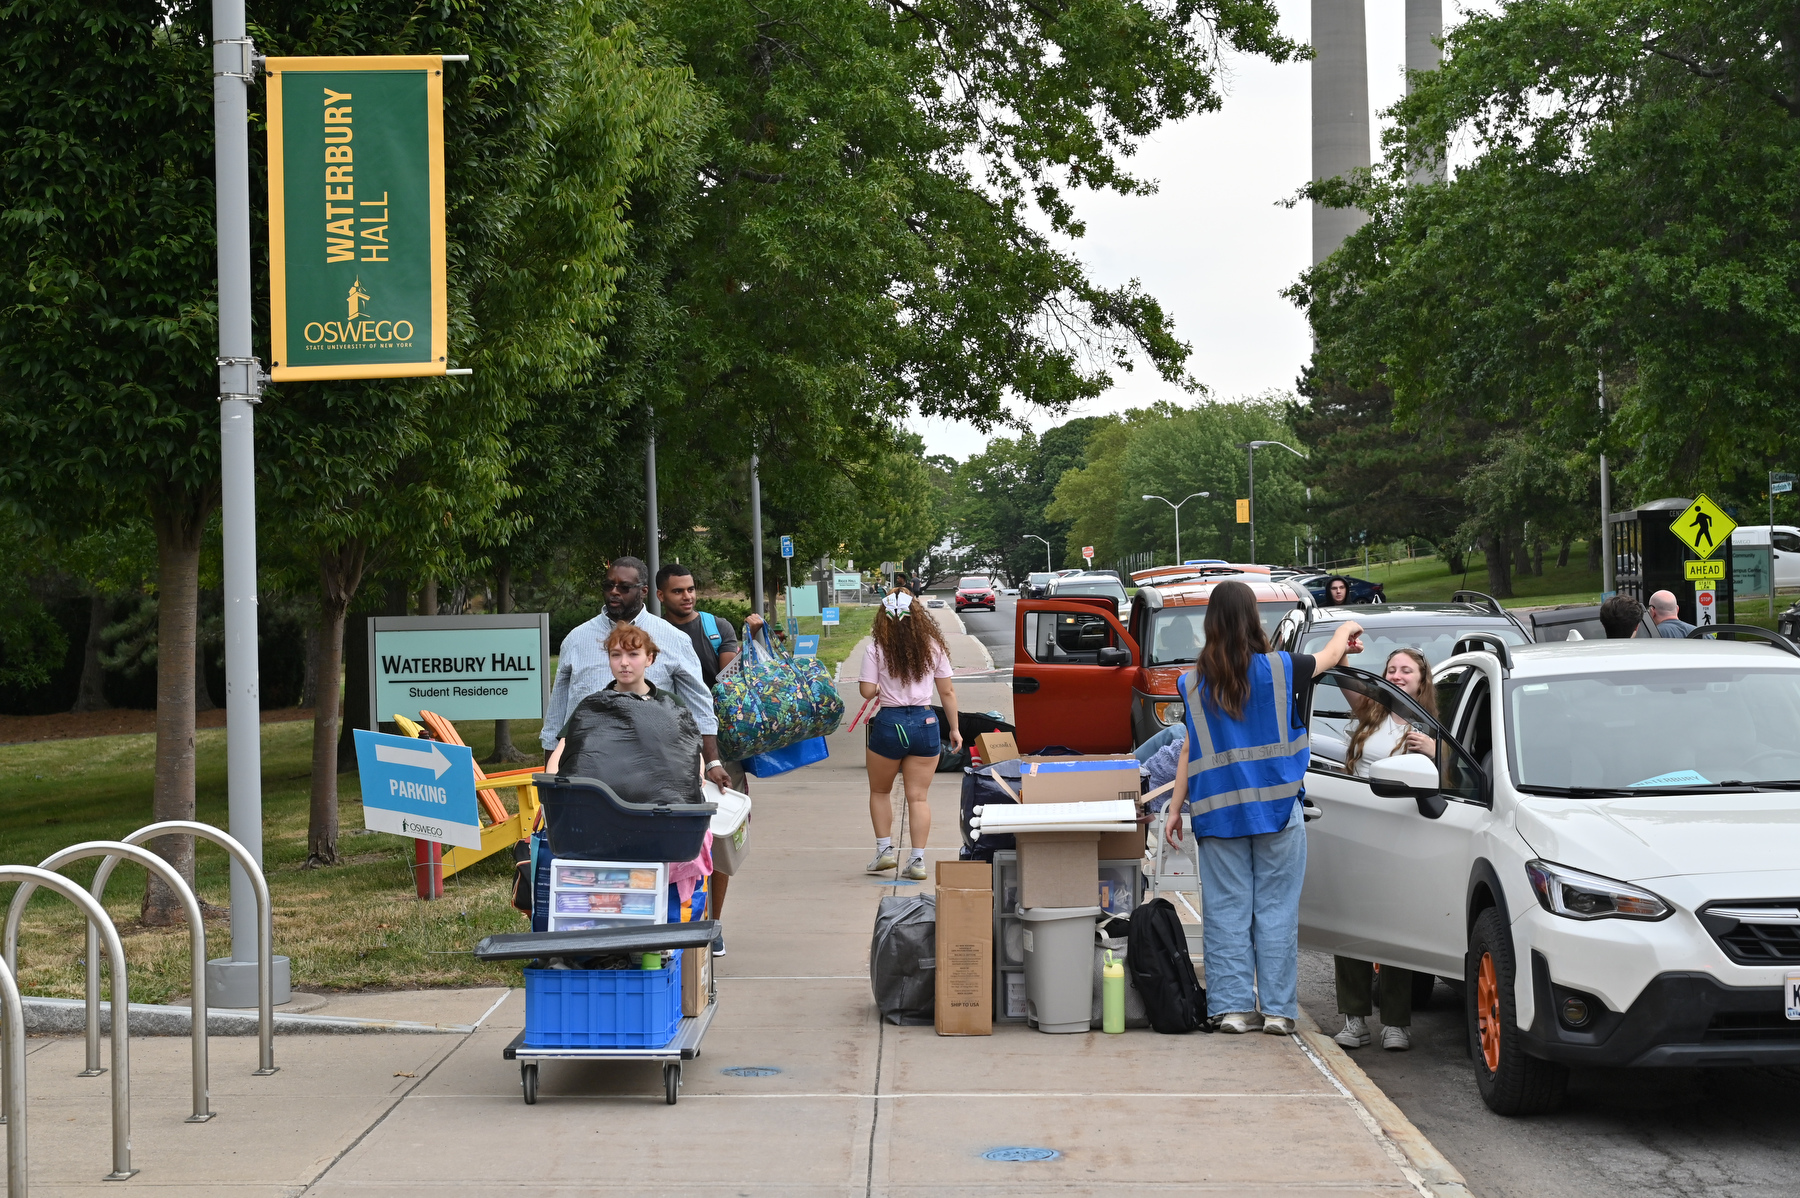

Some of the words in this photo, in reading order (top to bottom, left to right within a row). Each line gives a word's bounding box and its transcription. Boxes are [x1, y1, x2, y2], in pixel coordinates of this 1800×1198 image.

[324, 88, 355, 264] WATERBURY
[360, 191, 389, 262] HALL
[304, 320, 414, 343] OSWEGO
[1690, 565, 1720, 575] AHEAD
[381, 655, 486, 674] WATERBURY
[492, 653, 535, 672] HALL
[409, 687, 449, 697] Student
[453, 685, 508, 697] Residence
[1211, 751, 1234, 766] MOVE
[1239, 750, 1253, 760] IN
[1258, 744, 1285, 757] STAFF
[389, 779, 447, 805] PARKING
[410, 822, 443, 837] OSWEGO
